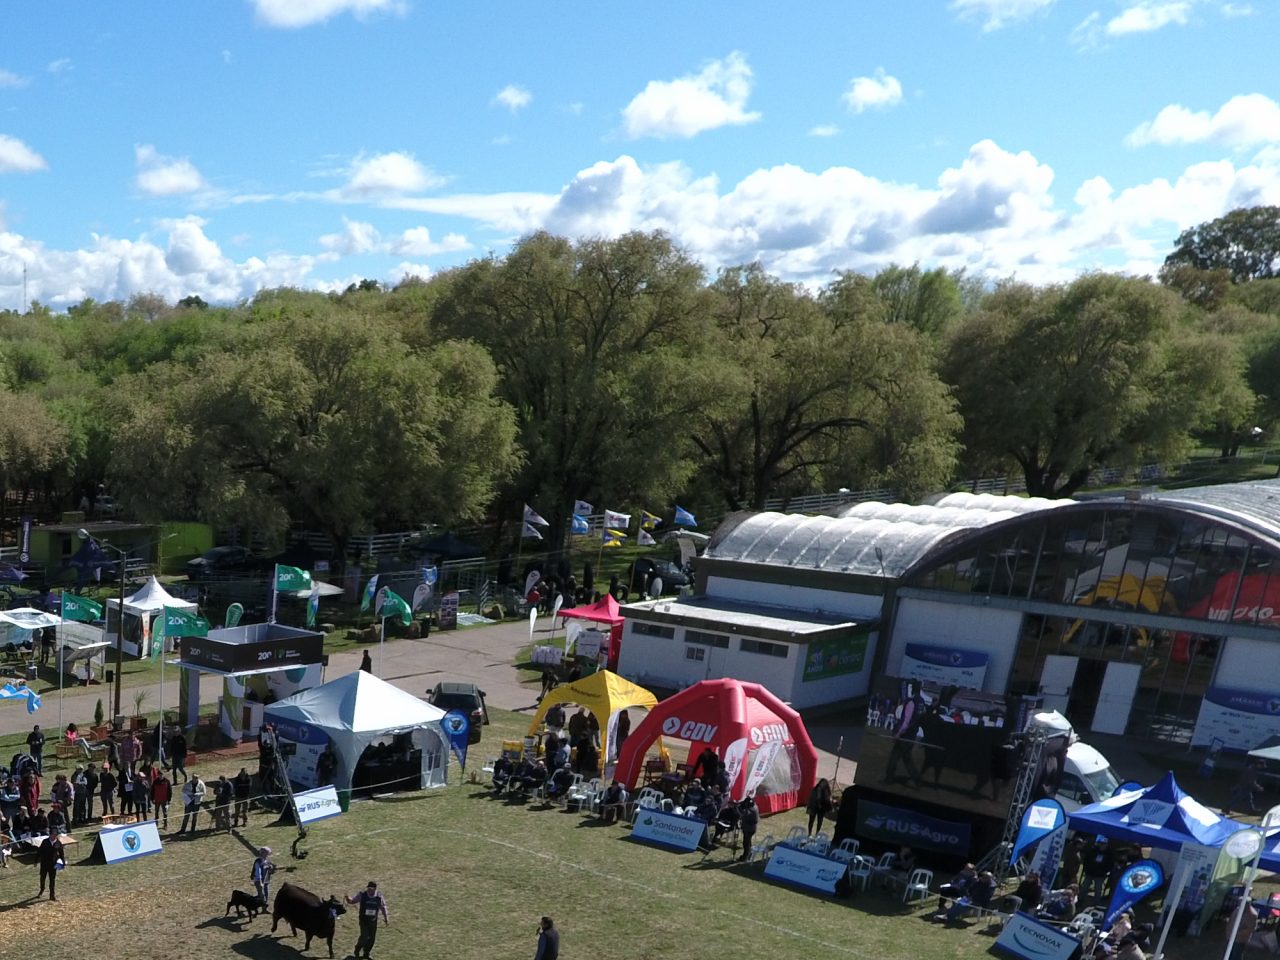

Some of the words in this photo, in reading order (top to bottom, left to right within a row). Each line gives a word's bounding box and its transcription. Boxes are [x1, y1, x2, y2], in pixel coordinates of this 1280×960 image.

[681, 721, 718, 743] CDV
[762, 722, 790, 744] CDV
[654, 820, 694, 835] Santander
[1019, 924, 1062, 949] TECNOVAX
